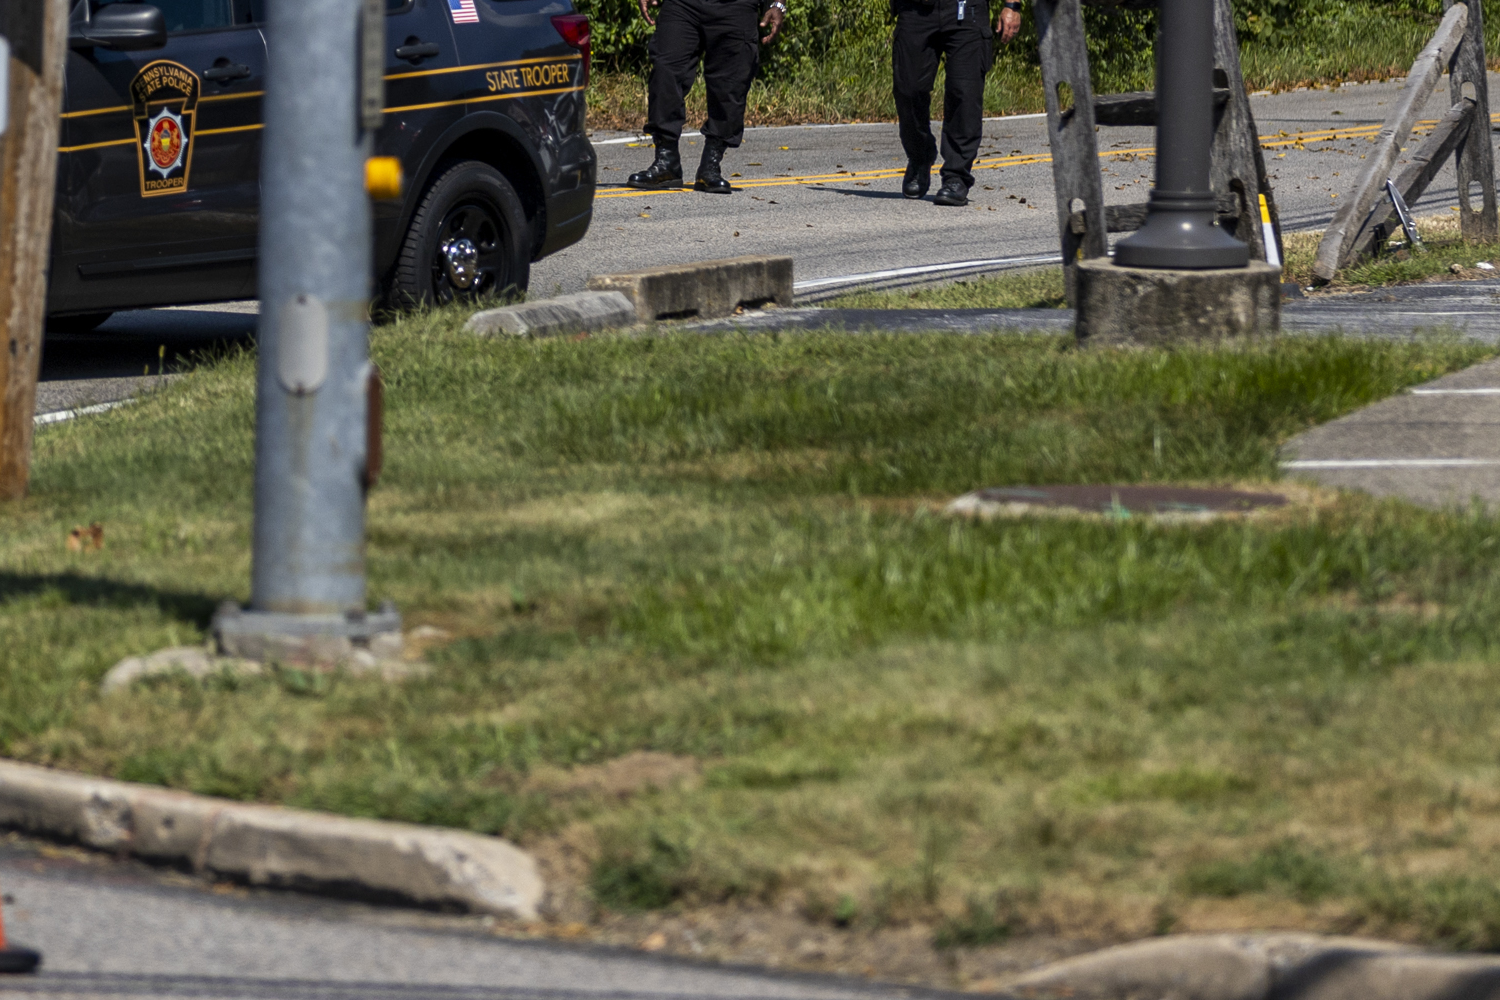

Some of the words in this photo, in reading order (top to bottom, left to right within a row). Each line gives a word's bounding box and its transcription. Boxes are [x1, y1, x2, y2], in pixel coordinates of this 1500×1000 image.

[135, 66, 193, 92] PENNSYLVANIA
[139, 78, 162, 102] STATE
[162, 76, 192, 97] POLICE
[485, 68, 521, 92] STATE
[520, 63, 570, 87] TROOPER
[145, 177, 184, 190] TROOPER
